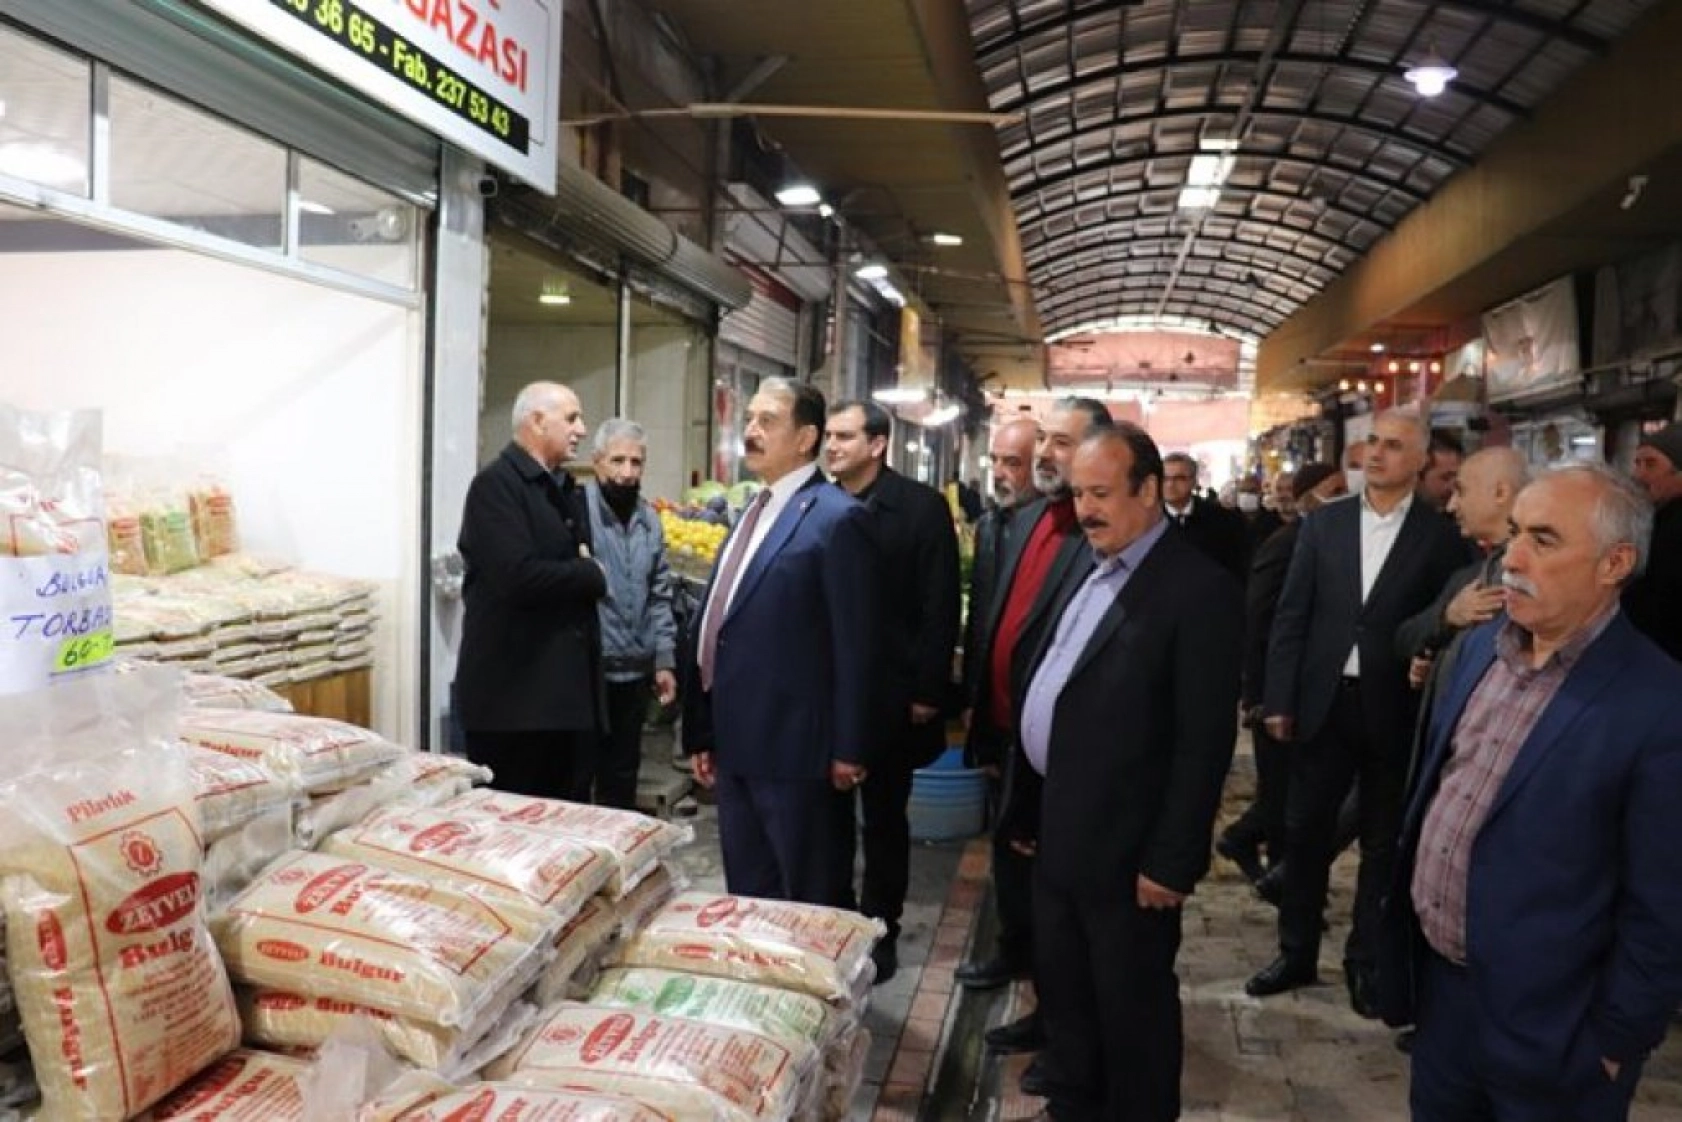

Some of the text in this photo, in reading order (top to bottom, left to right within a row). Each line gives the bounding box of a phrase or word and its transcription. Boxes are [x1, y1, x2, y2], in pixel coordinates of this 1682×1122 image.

[314, 0, 344, 34] 36
[348, 12, 376, 53] 65
[393, 38, 432, 90] Fab.
[436, 69, 466, 108] 237
[468, 90, 489, 123] 53
[491, 105, 510, 137] 43
[319, 949, 406, 983] Bulgur
